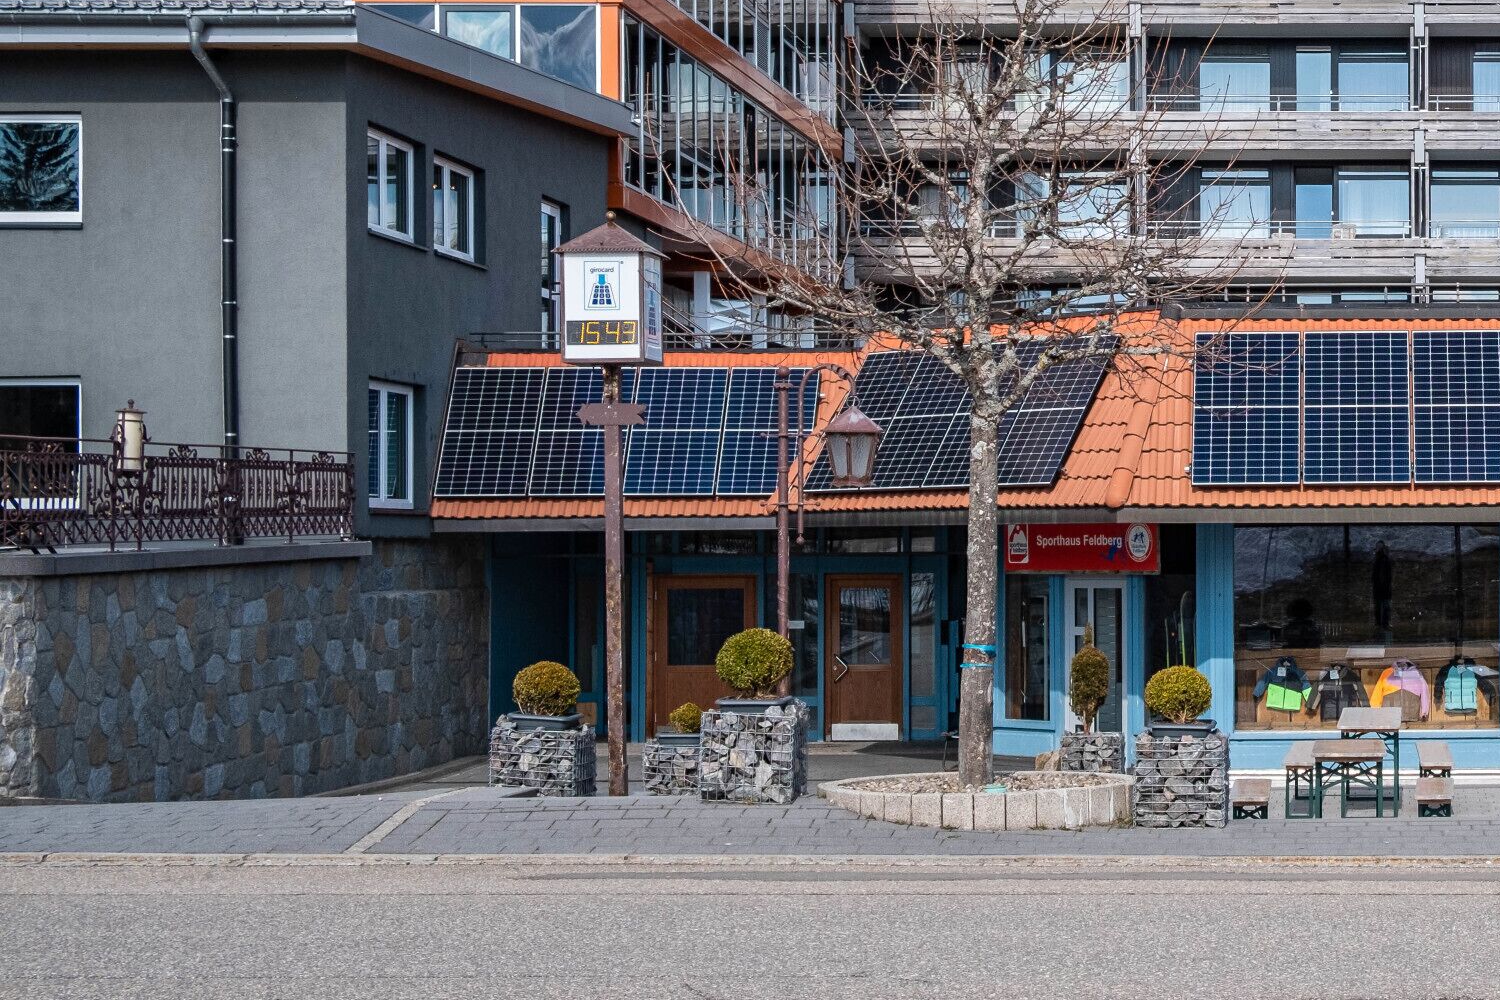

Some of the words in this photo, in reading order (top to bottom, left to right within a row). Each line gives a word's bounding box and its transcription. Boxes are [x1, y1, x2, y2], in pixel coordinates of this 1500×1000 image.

[589, 266, 615, 274] girocard
[1036, 534, 1081, 549] Sporthaus
[1083, 534, 1123, 549] Feldberg
